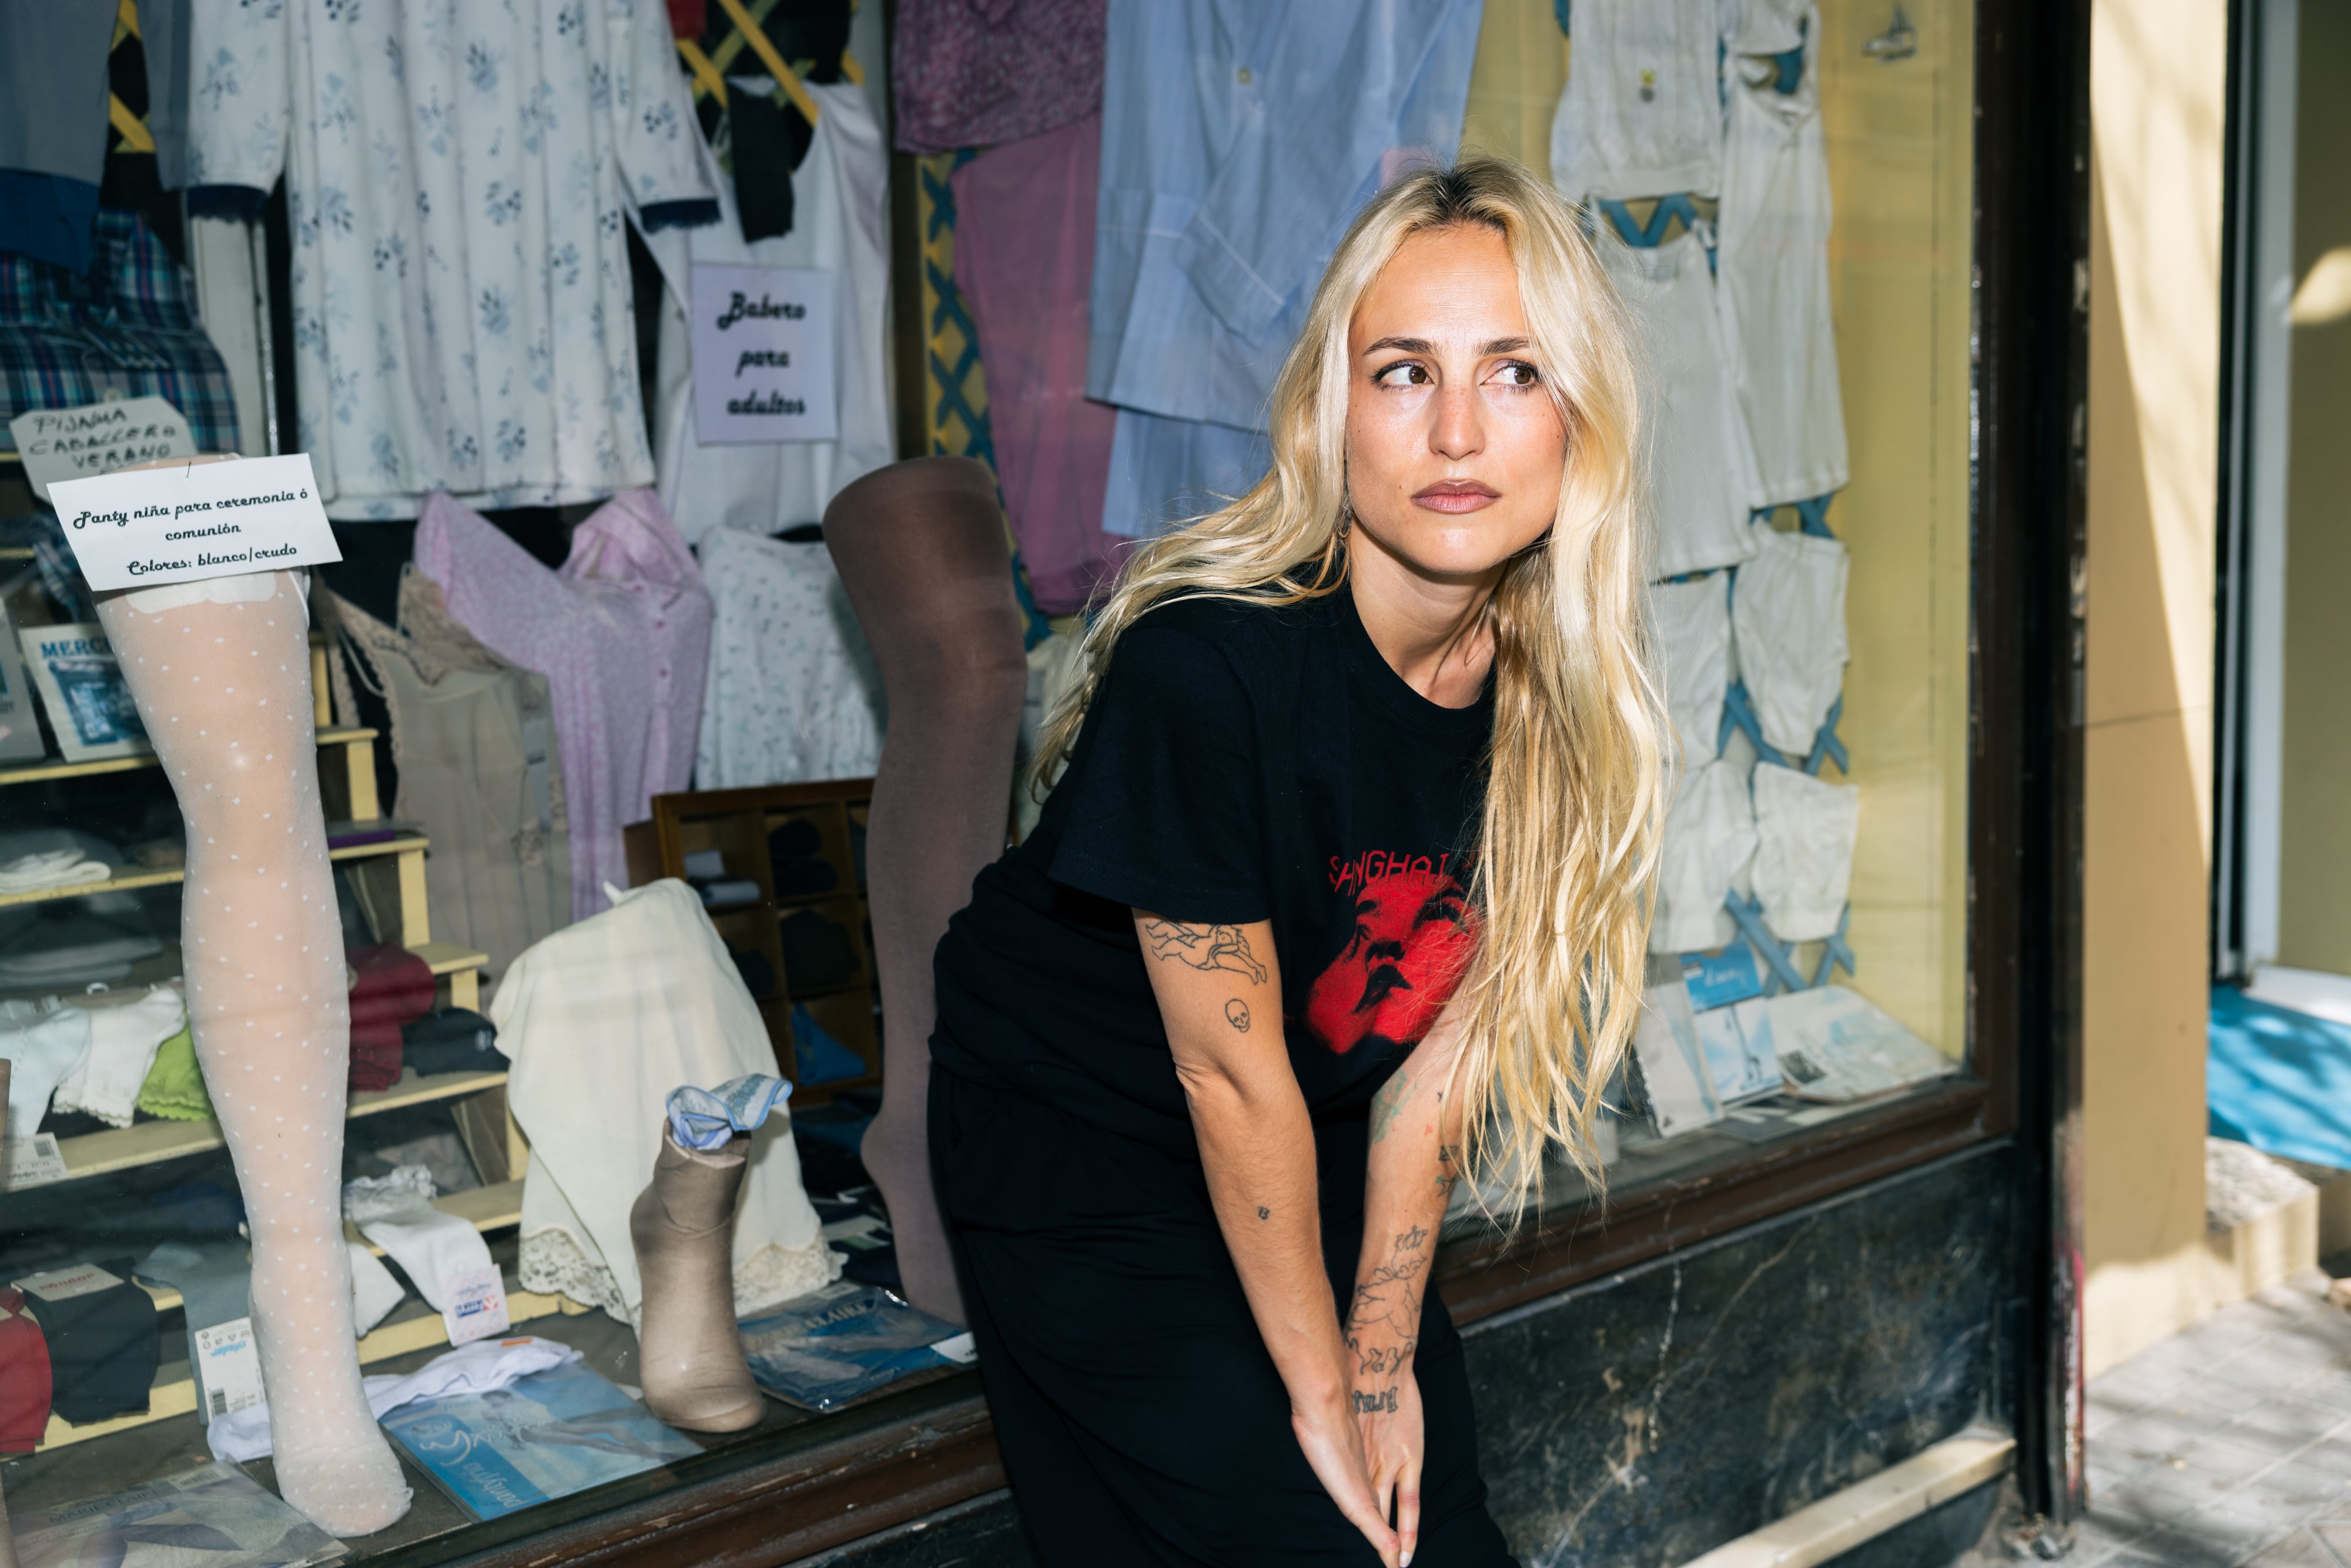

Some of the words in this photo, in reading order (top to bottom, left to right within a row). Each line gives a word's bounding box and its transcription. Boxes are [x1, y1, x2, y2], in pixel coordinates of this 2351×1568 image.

[716, 291, 806, 331] Babero
[735, 348, 789, 378] para
[726, 387, 806, 416] adultos
[33, 407, 127, 435] PIJAMA
[29, 424, 176, 455] CABALLERO
[71, 442, 171, 468] VERANO
[73, 511, 129, 530] Panty
[133, 505, 170, 519] niña
[175, 501, 212, 520] para
[216, 491, 296, 509] ceremonia
[300, 488, 308, 500] ó
[165, 522, 242, 541] comunión
[126, 559, 192, 575] Colores:
[197, 542, 297, 566] blanco/crudo
